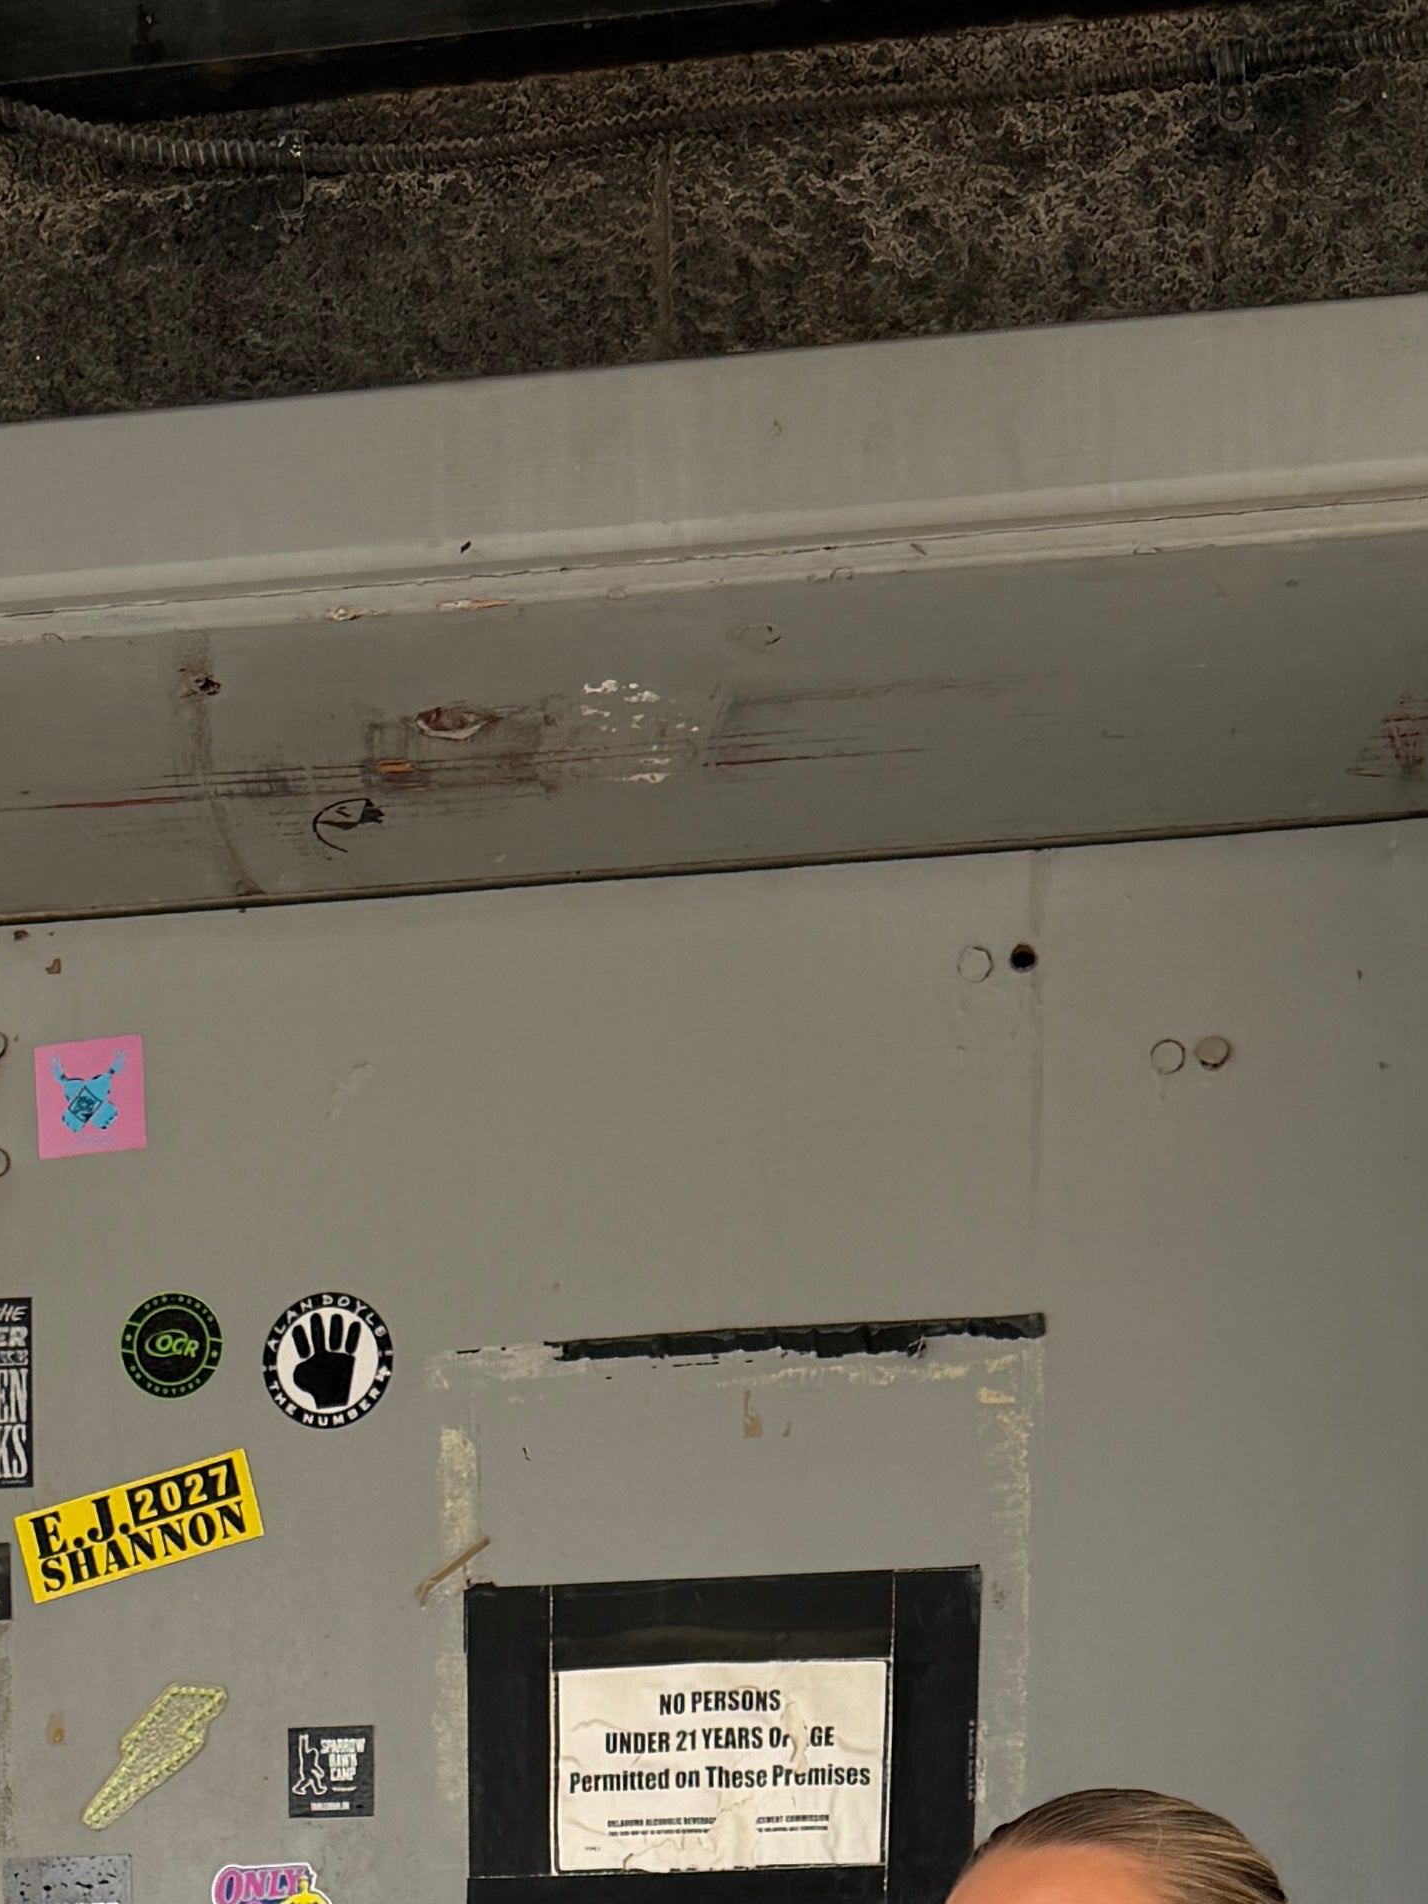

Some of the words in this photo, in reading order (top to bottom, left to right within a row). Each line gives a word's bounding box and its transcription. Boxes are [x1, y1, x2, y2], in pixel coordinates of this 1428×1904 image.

[267, 1298, 313, 1353] ALAN
[269, 1381, 298, 1416] THE
[302, 1387, 381, 1427] NUMBER
[30, 1495, 131, 1560] E.J.
[134, 1464, 228, 1522] 2027
[41, 1500, 247, 1593] SHANNON
[659, 1692, 685, 1715] NO
[691, 1689, 781, 1713] PERSONS
[605, 1731, 670, 1754] UNDER
[676, 1729, 697, 1751] 21
[702, 1726, 763, 1749] YEARS
[807, 1726, 834, 1747] GE
[570, 1768, 669, 1793] Permitted
[675, 1770, 700, 1788] on
[705, 1765, 767, 1789] These
[772, 1764, 871, 1787] Premises
